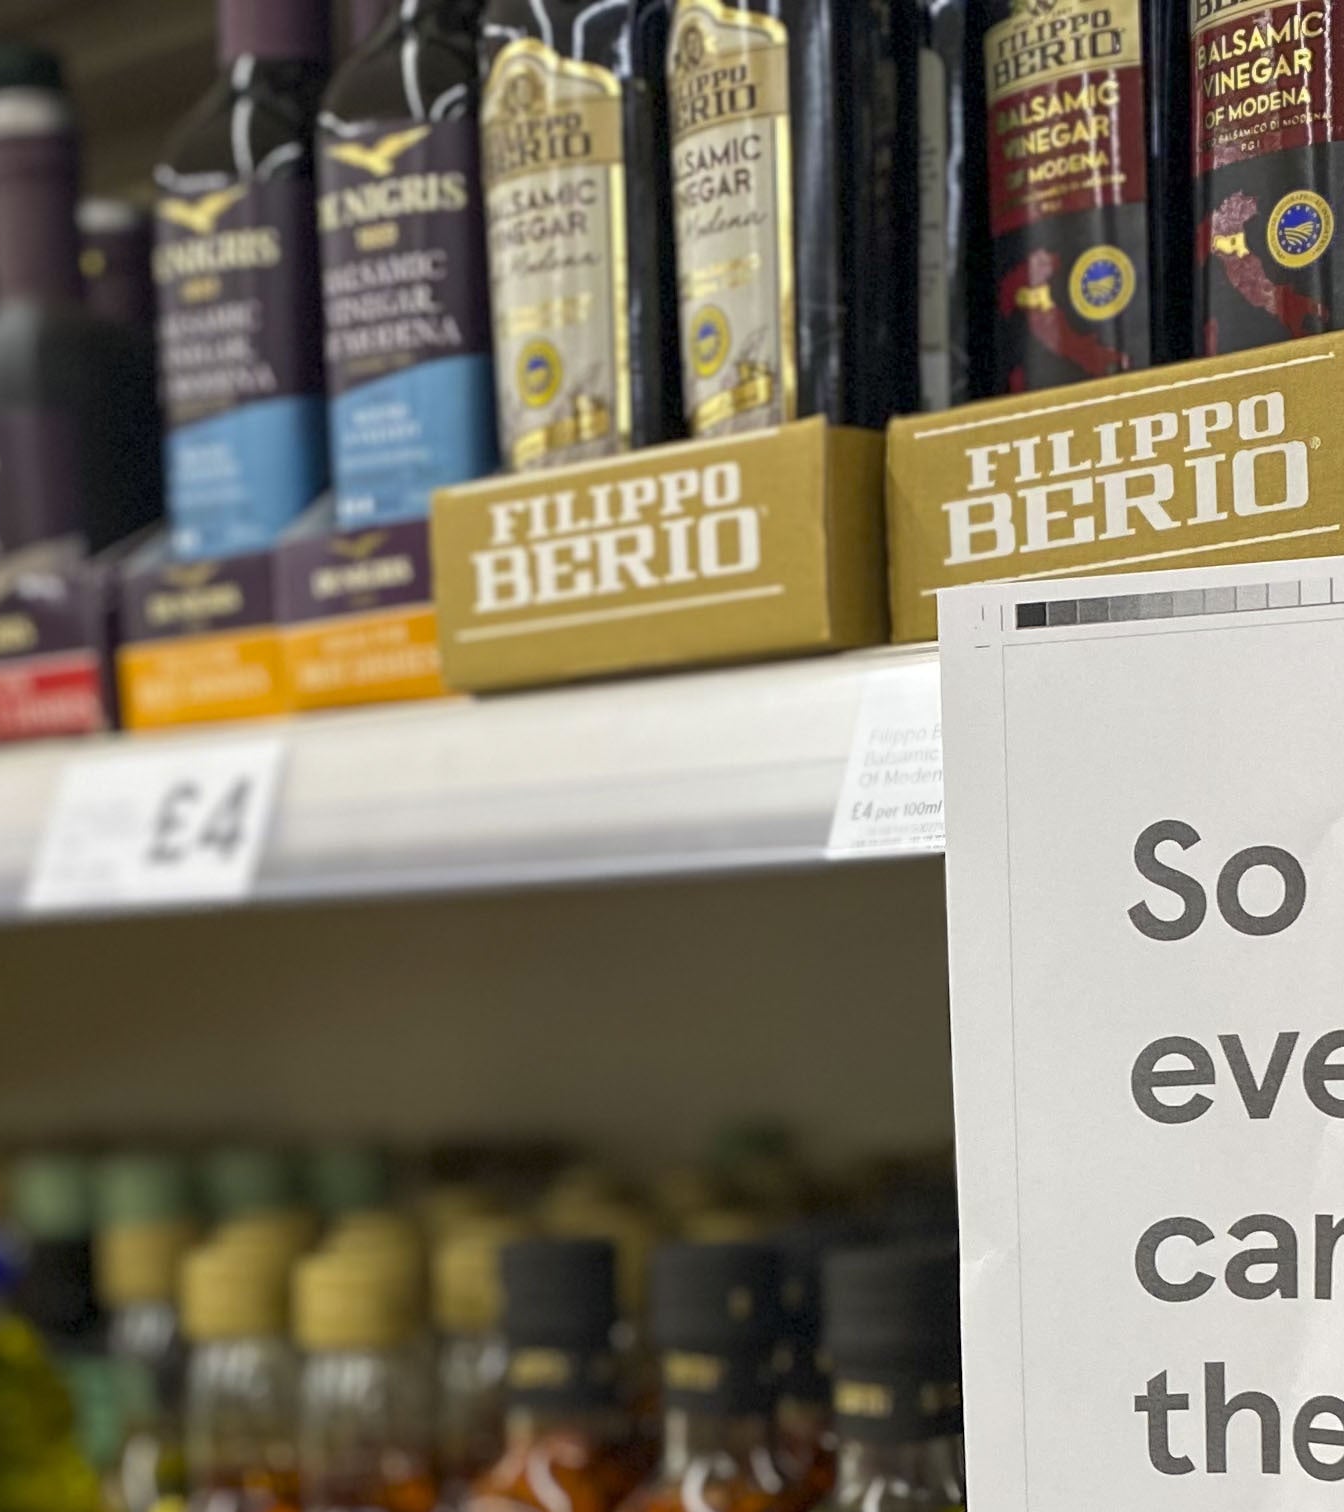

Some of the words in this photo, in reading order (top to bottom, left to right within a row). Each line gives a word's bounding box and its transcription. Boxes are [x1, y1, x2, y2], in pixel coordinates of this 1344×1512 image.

[993, 29, 1122, 89] BERIO
[997, 9, 1111, 57] FILIPPO
[1197, 11, 1324, 70] BALSAMIC
[1204, 48, 1312, 97] VINEGAR
[996, 80, 1120, 134] BALSAMIC
[1206, 106, 1224, 129] OF
[1229, 86, 1312, 122] MODENA
[1004, 116, 1110, 158] VINEGAR
[1027, 151, 1109, 185] MODENA
[966, 390, 1286, 493] FILIPPO
[489, 461, 741, 549] FILIPPO
[941, 440, 1310, 568] BERIO
[471, 506, 762, 614] BERIO
[882, 768, 943, 787] Moden
[142, 775, 255, 867] £4
[1127, 818, 1308, 942] So
